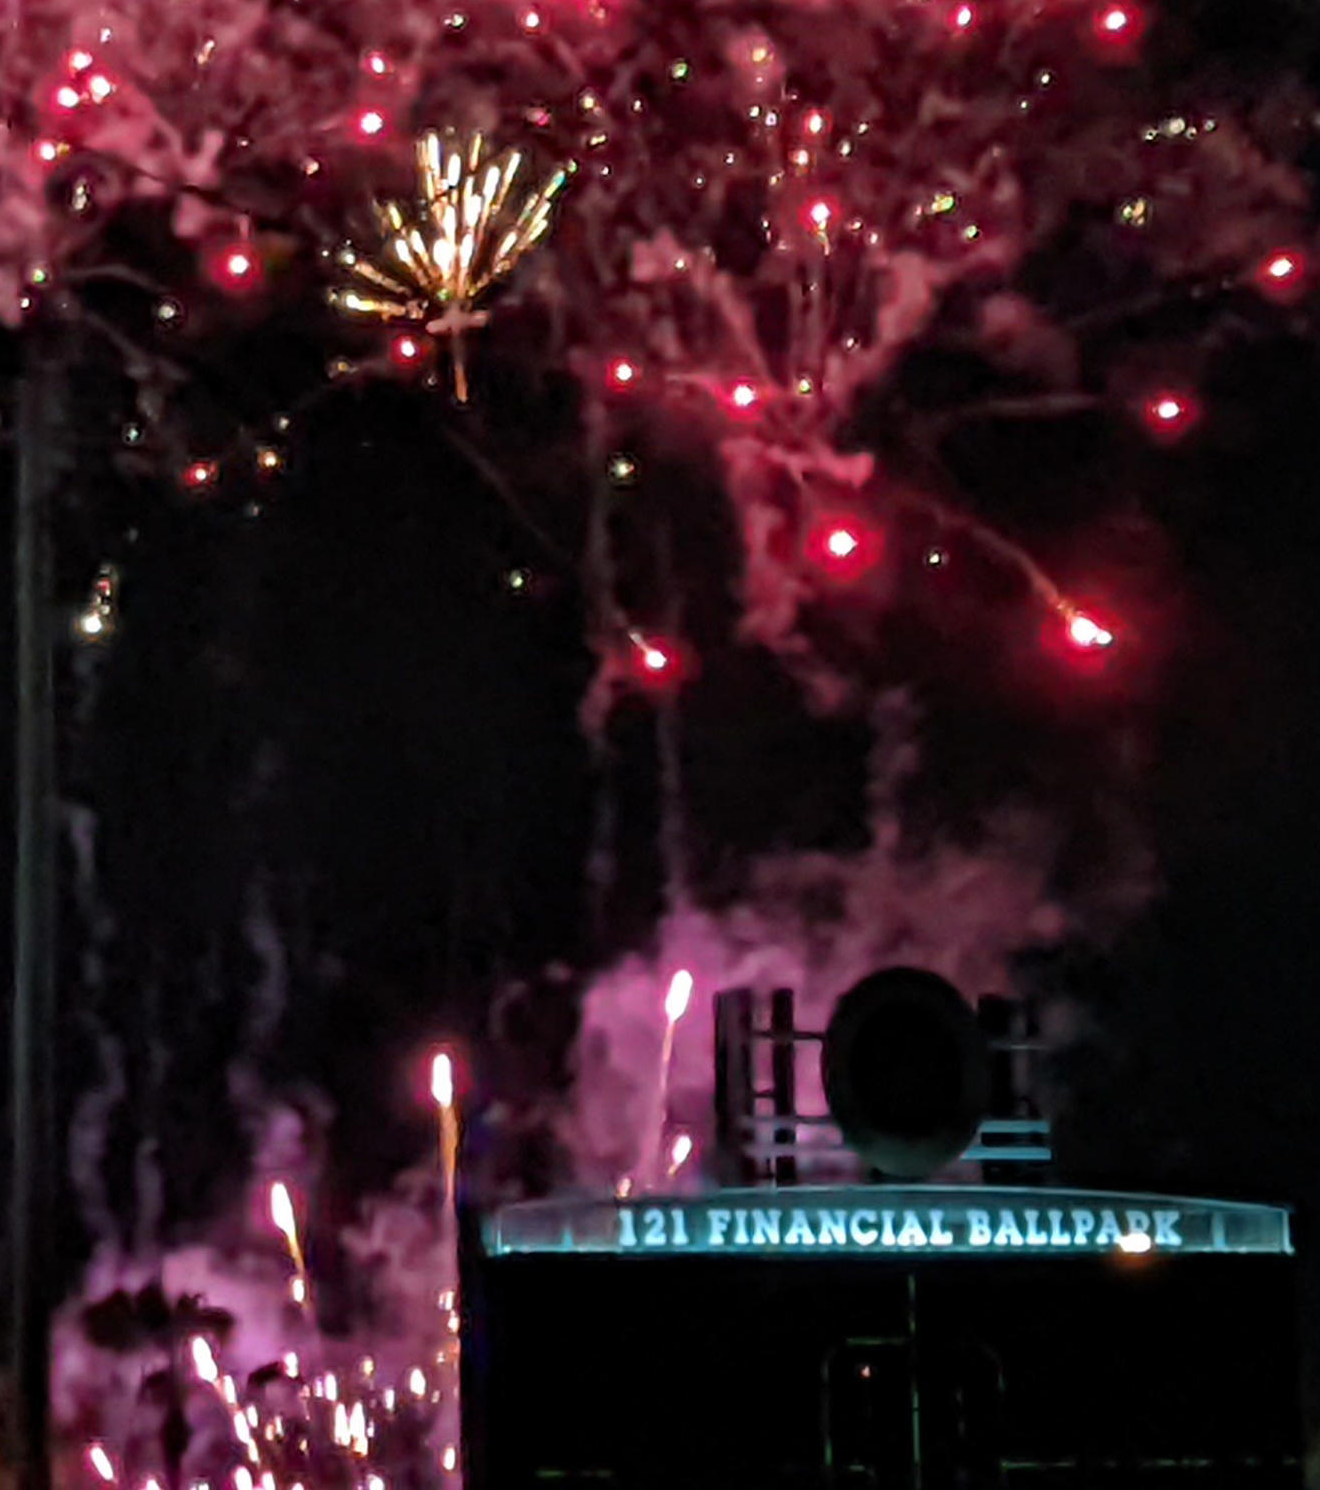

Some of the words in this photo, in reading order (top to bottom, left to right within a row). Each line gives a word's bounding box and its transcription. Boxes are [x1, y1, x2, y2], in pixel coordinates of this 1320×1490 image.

[618, 1209, 689, 1246] 121
[707, 1209, 953, 1246] FINANCIAL
[966, 1209, 1182, 1246] BALLPARK
